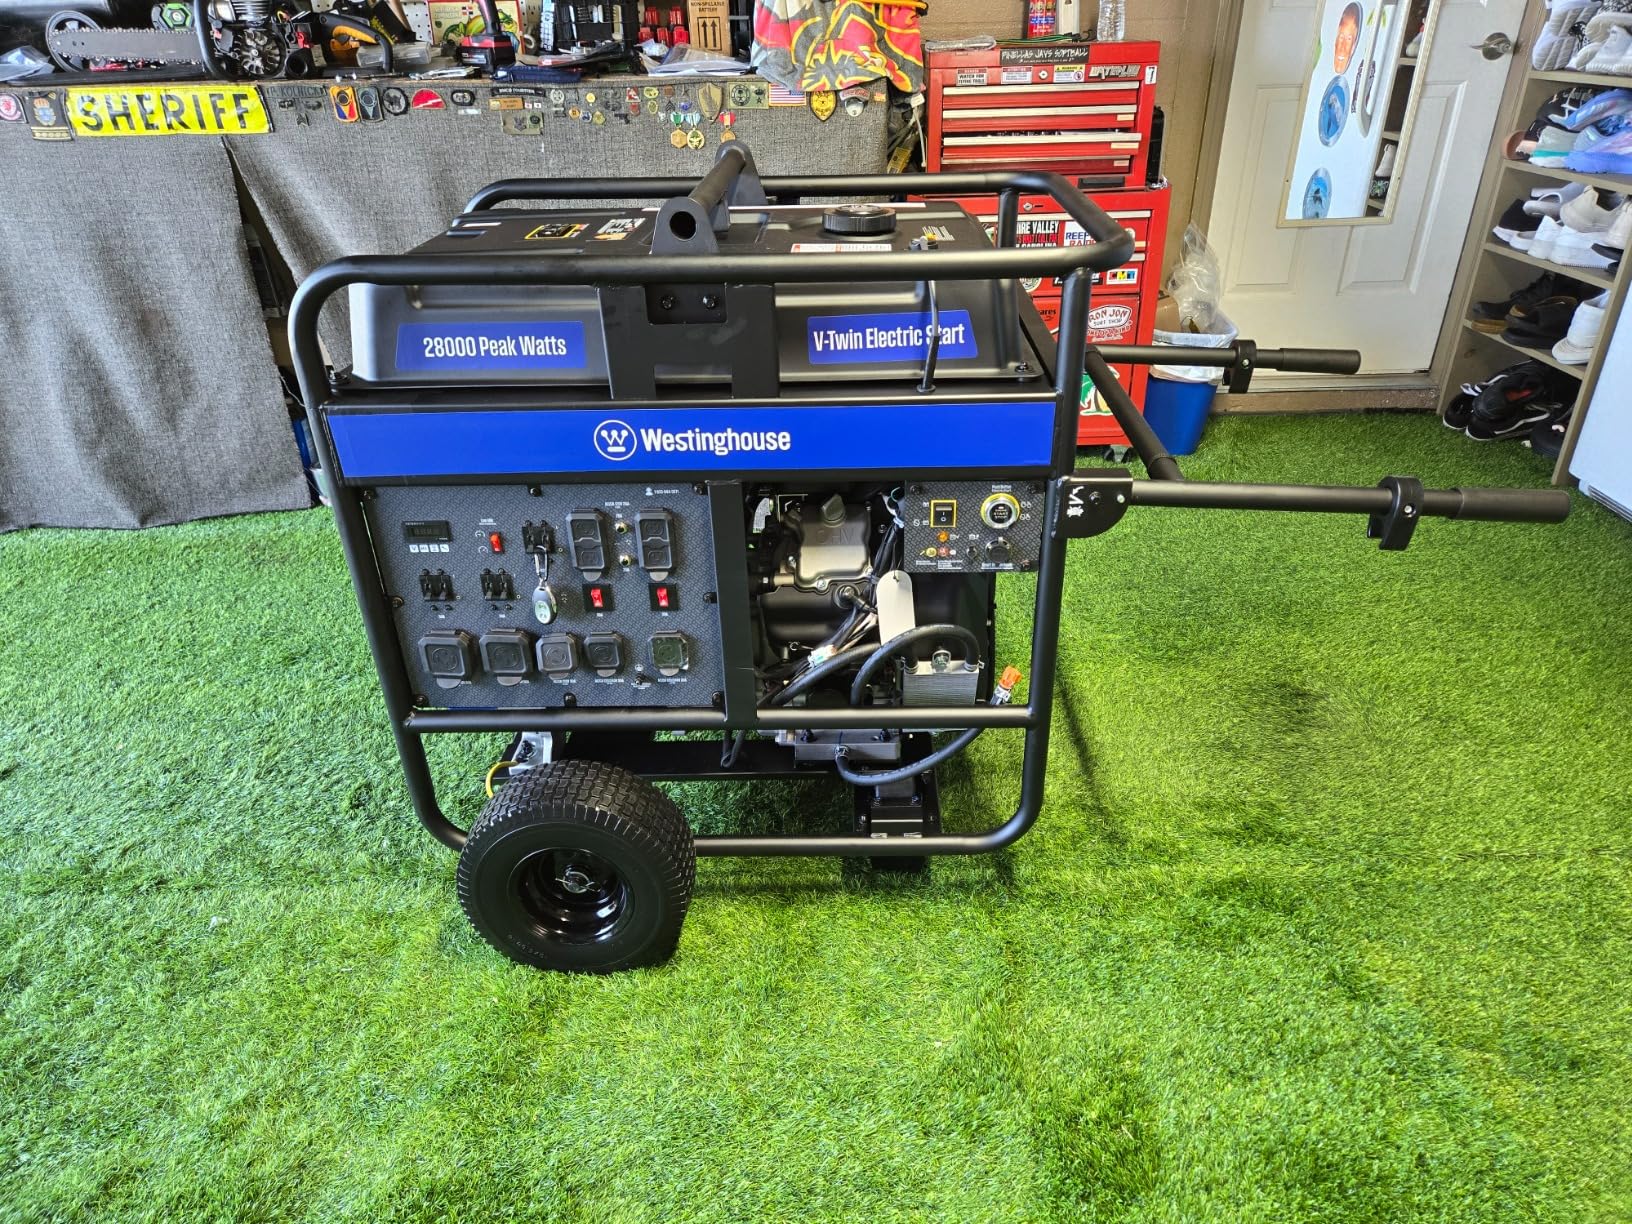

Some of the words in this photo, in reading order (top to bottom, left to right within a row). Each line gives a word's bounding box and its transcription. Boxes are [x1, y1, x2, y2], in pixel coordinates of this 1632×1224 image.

[1002, 50, 1034, 60] PINELLAS
[1035, 49, 1053, 58] JAYS
[1054, 47, 1089, 58] SOFTBALL
[76, 93, 250, 132] SHERIFF
[1033, 220, 1059, 234] VALLEY
[1088, 309, 1107, 323] RON
[1109, 308, 1128, 318] JON
[423, 336, 477, 358] 28000
[479, 336, 518, 357] Peak
[519, 336, 567, 356] Watts
[813, 329, 863, 352] V-Twin
[866, 326, 923, 349] Electric
[640, 428, 791, 456] Westinghouse
